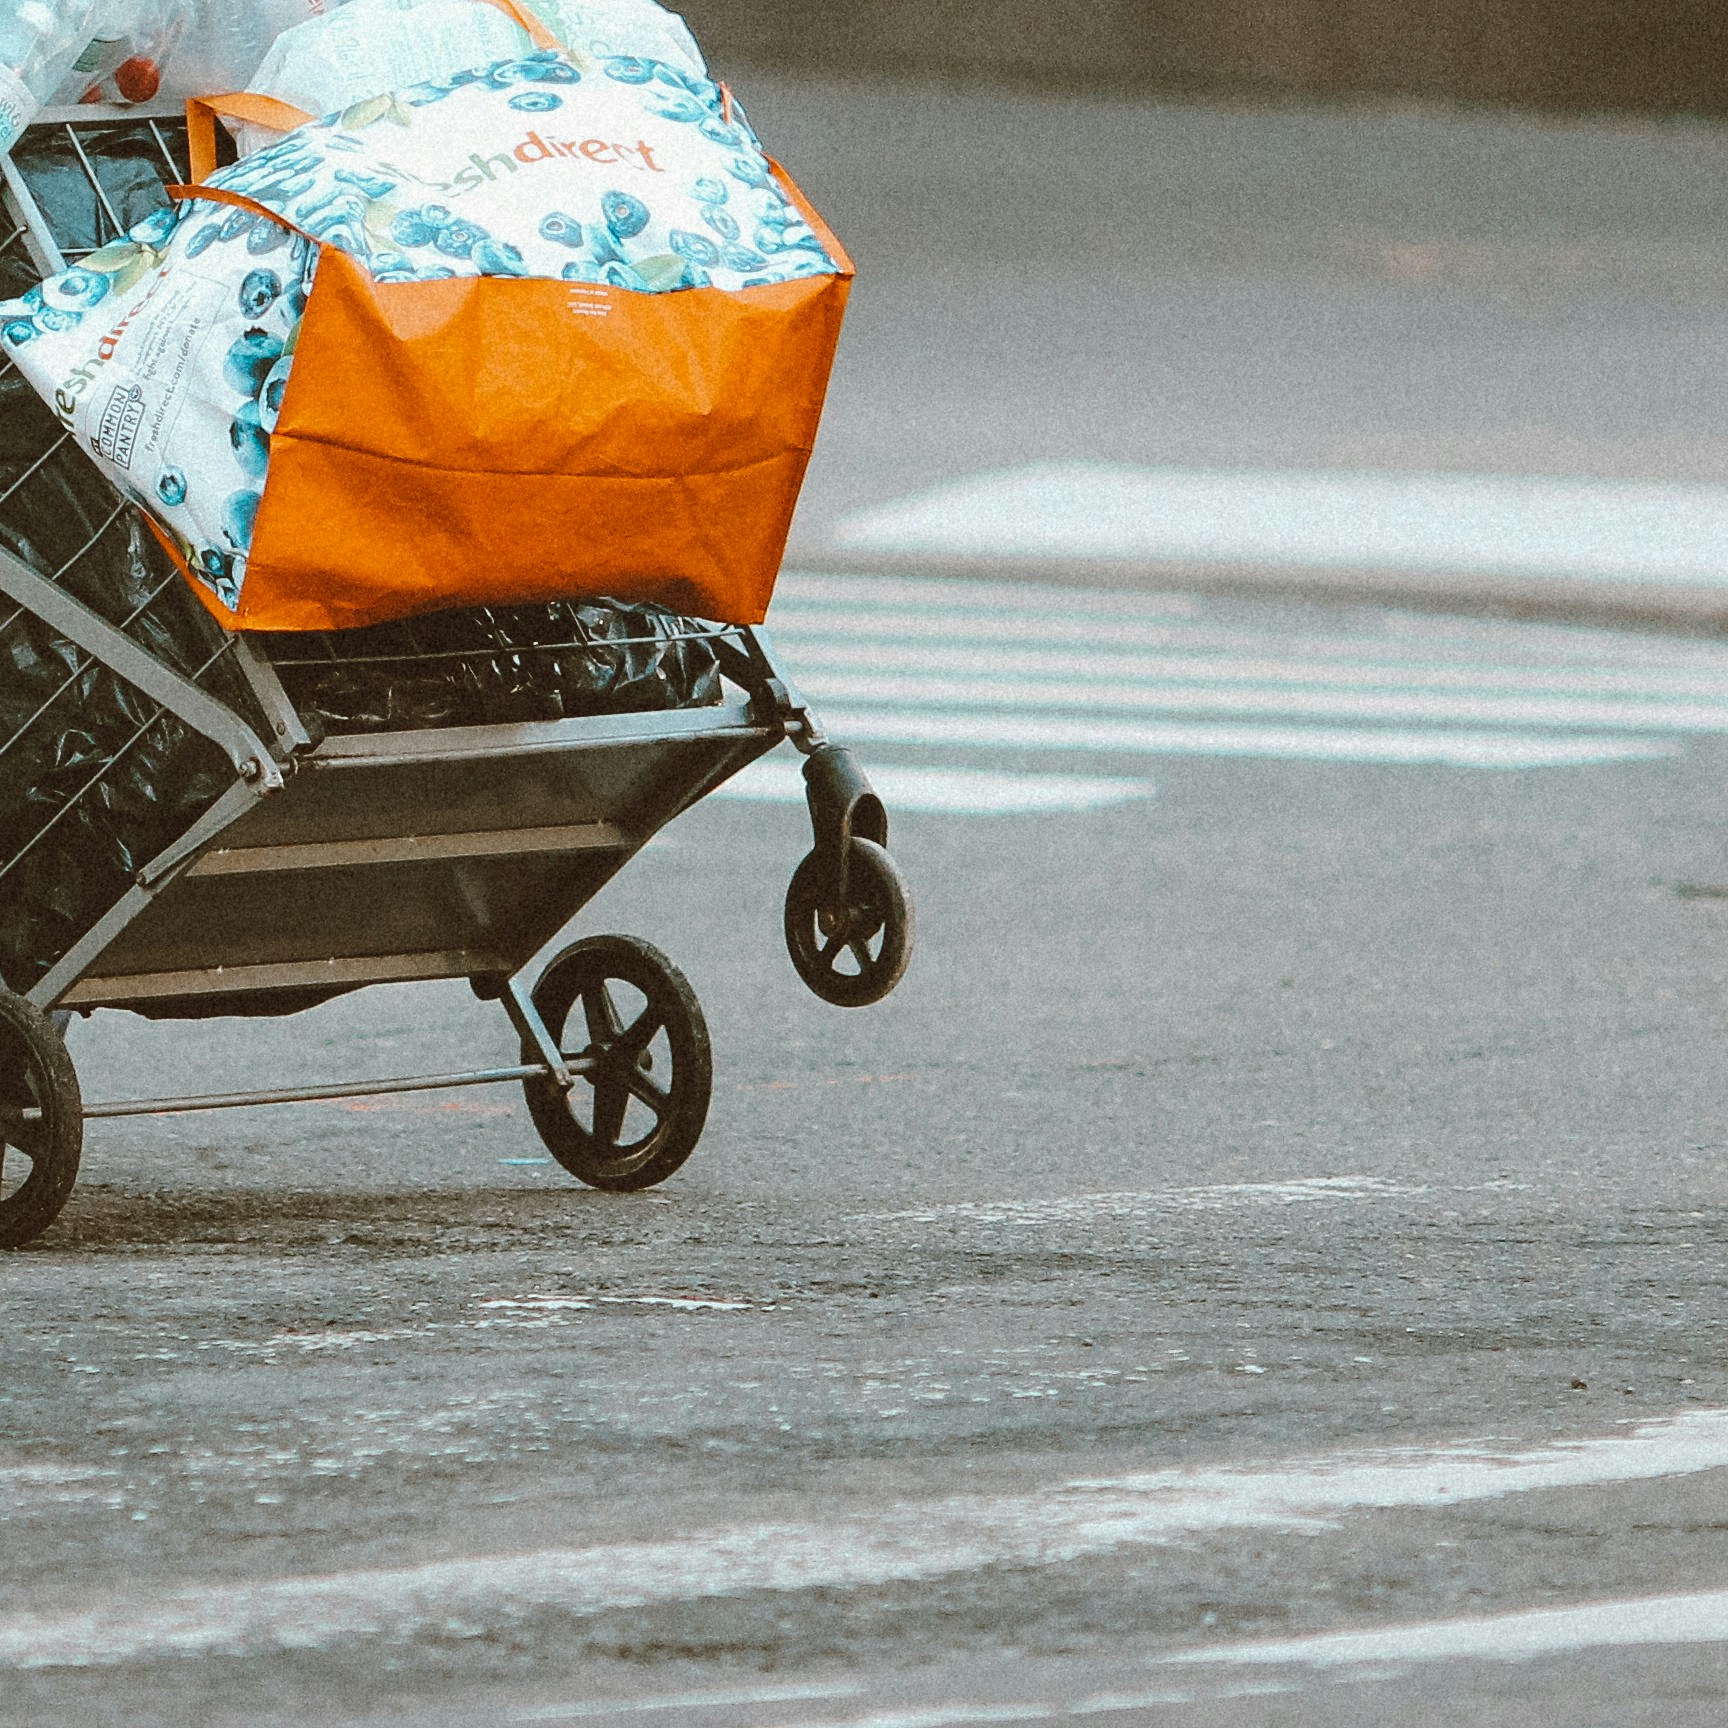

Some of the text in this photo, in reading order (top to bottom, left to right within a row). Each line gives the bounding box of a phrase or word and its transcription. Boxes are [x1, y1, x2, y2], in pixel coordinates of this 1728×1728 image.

[143, 317, 202, 453] freshdirect.com/donate
[102, 390, 129, 457] COMMON
[115, 406, 140, 465] PANTRY
